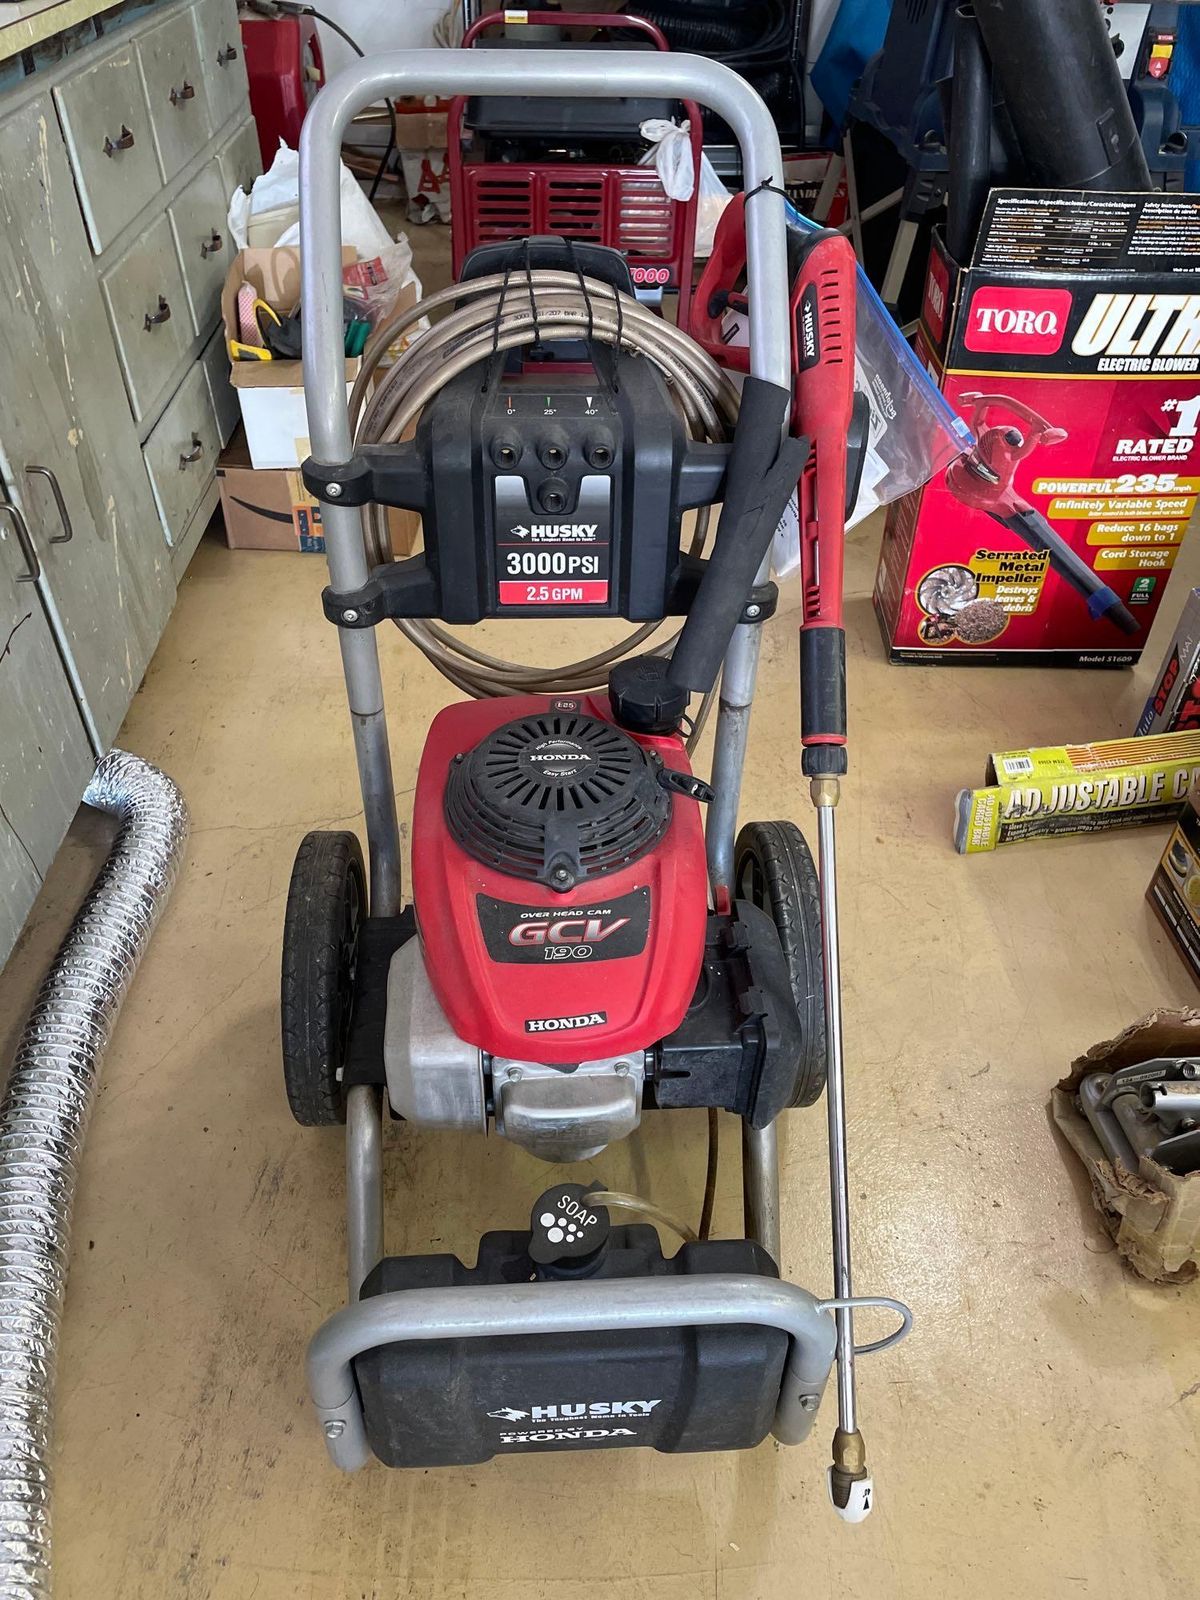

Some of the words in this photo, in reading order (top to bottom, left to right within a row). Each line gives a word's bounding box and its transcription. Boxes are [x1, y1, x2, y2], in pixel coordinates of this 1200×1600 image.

[976, 308, 1058, 335] TORO
[1071, 293, 1200, 357] ULTR
[803, 312, 815, 357] HUSKY
[1097, 358, 1150, 371] ELECTRIC
[1151, 358, 1199, 371] BLOWER
[1160, 395, 1200, 437] #1
[1115, 438, 1194, 454] RATED
[1037, 482, 1113, 493] POWERFUL
[1055, 500, 1105, 511] Infinitely
[1108, 500, 1152, 509] Variable
[1155, 499, 1188, 510] Speed
[530, 524, 598, 538] HUSKY
[1097, 523, 1135, 532] Reduce
[1139, 524, 1151, 532] 16
[1153, 522, 1179, 532] bags
[1121, 534, 1150, 542] down
[1170, 533, 1175, 541] 1
[976, 550, 1048, 560] Serrated
[1102, 550, 1126, 559] Cord
[1127, 550, 1169, 559] Storage
[507, 552, 566, 574] 3000
[568, 556, 599, 574] PSI
[999, 562, 1045, 572] Metal
[1139, 558, 1165, 567] Hook
[976, 573, 1041, 585] Impeller
[1138, 578, 1150, 588] 2
[526, 586, 549, 601] 2.5
[552, 588, 583, 600] GPM
[996, 586, 1039, 596] Destroys
[995, 595, 1024, 603] leaves
[1027, 595, 1037, 603] &
[1003, 603, 1033, 612] debris
[543, 769, 559, 777] Easy
[1003, 772, 1166, 819] ADJUSTABLE
[508, 917, 632, 947] GCV
[544, 945, 592, 960] 190
[528, 1013, 605, 1032] HONDA
[557, 1195, 598, 1226] SOAP
[531, 1400, 662, 1418] HUSKY
[500, 1428, 637, 1443] HONDA
